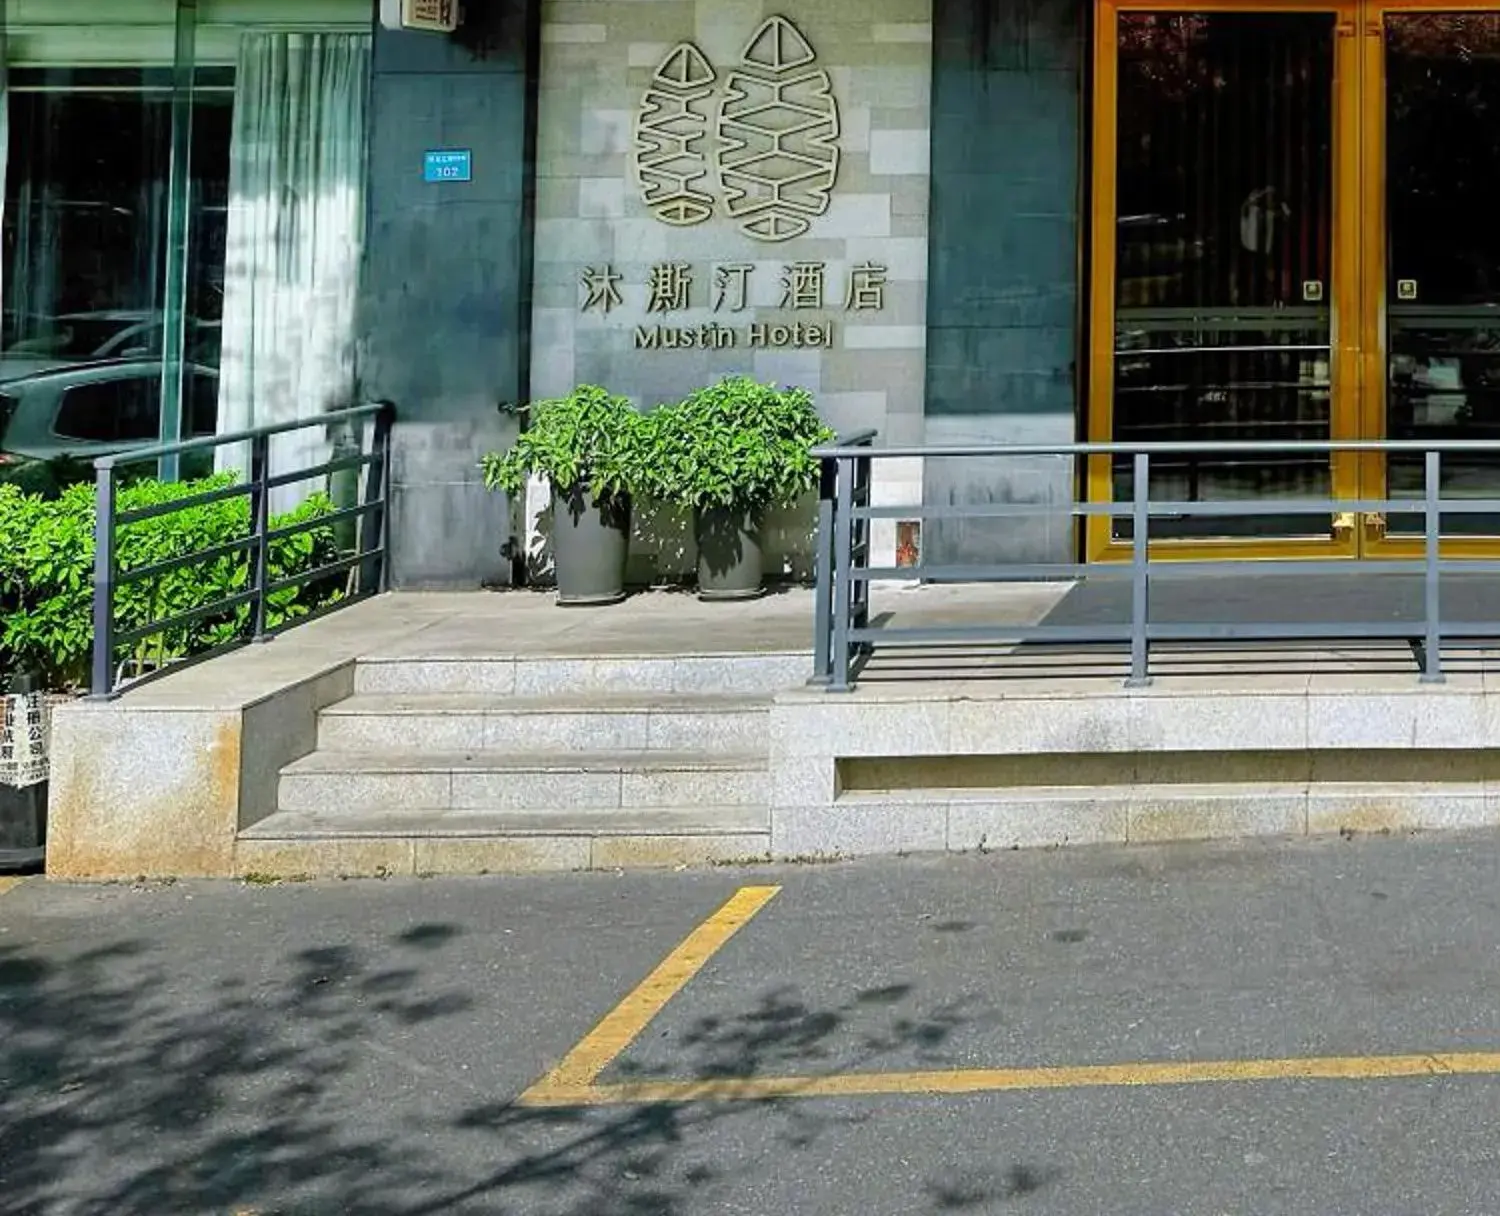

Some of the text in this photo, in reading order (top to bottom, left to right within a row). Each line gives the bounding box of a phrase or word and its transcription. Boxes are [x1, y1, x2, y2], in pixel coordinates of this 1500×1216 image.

[578, 260, 889, 316] 沐澌汀酒店
[632, 320, 834, 350] Mustin Hotel
